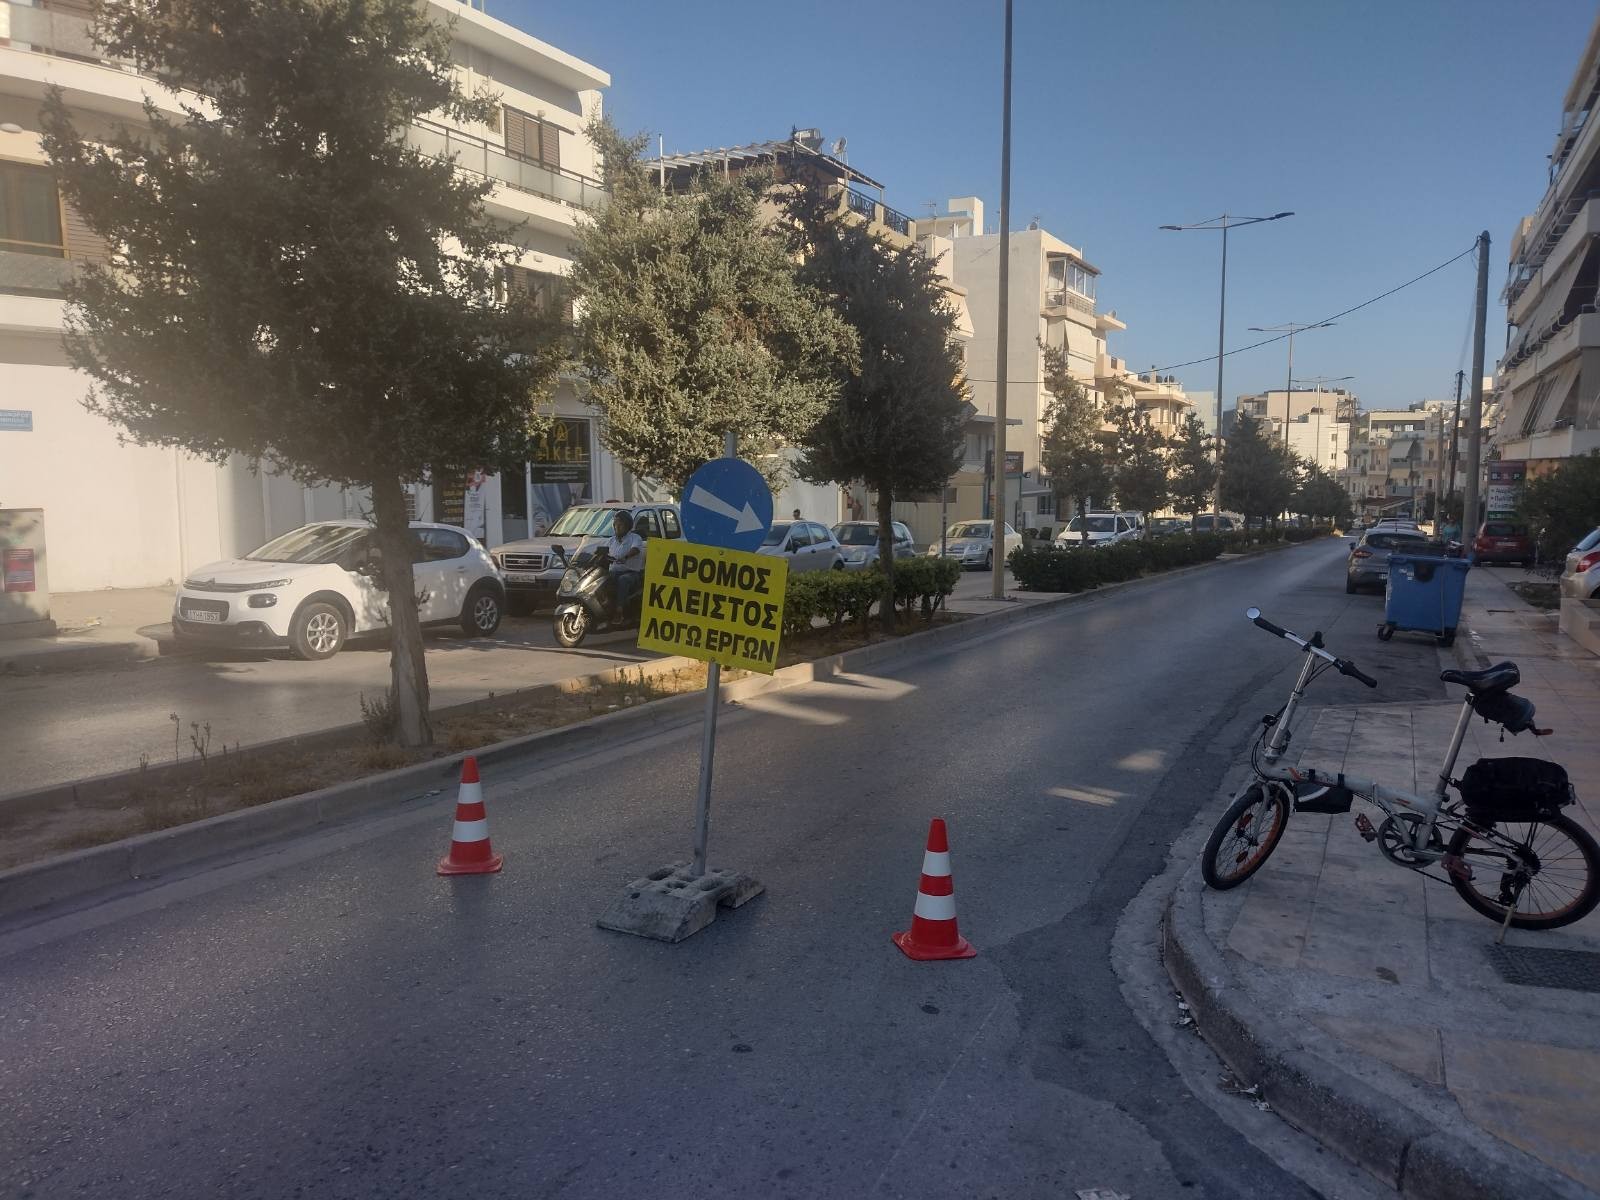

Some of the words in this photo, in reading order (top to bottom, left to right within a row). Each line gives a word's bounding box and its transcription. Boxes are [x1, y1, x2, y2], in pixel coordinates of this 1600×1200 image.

[662, 552, 771, 594] ΔΡΟΜΟΣ
[648, 583, 778, 630] ΚΛΕΙΣΤΟΣ
[645, 617, 702, 648] ΛΟΓΩ
[706, 628, 776, 663] ΕΡΓΩΝ
